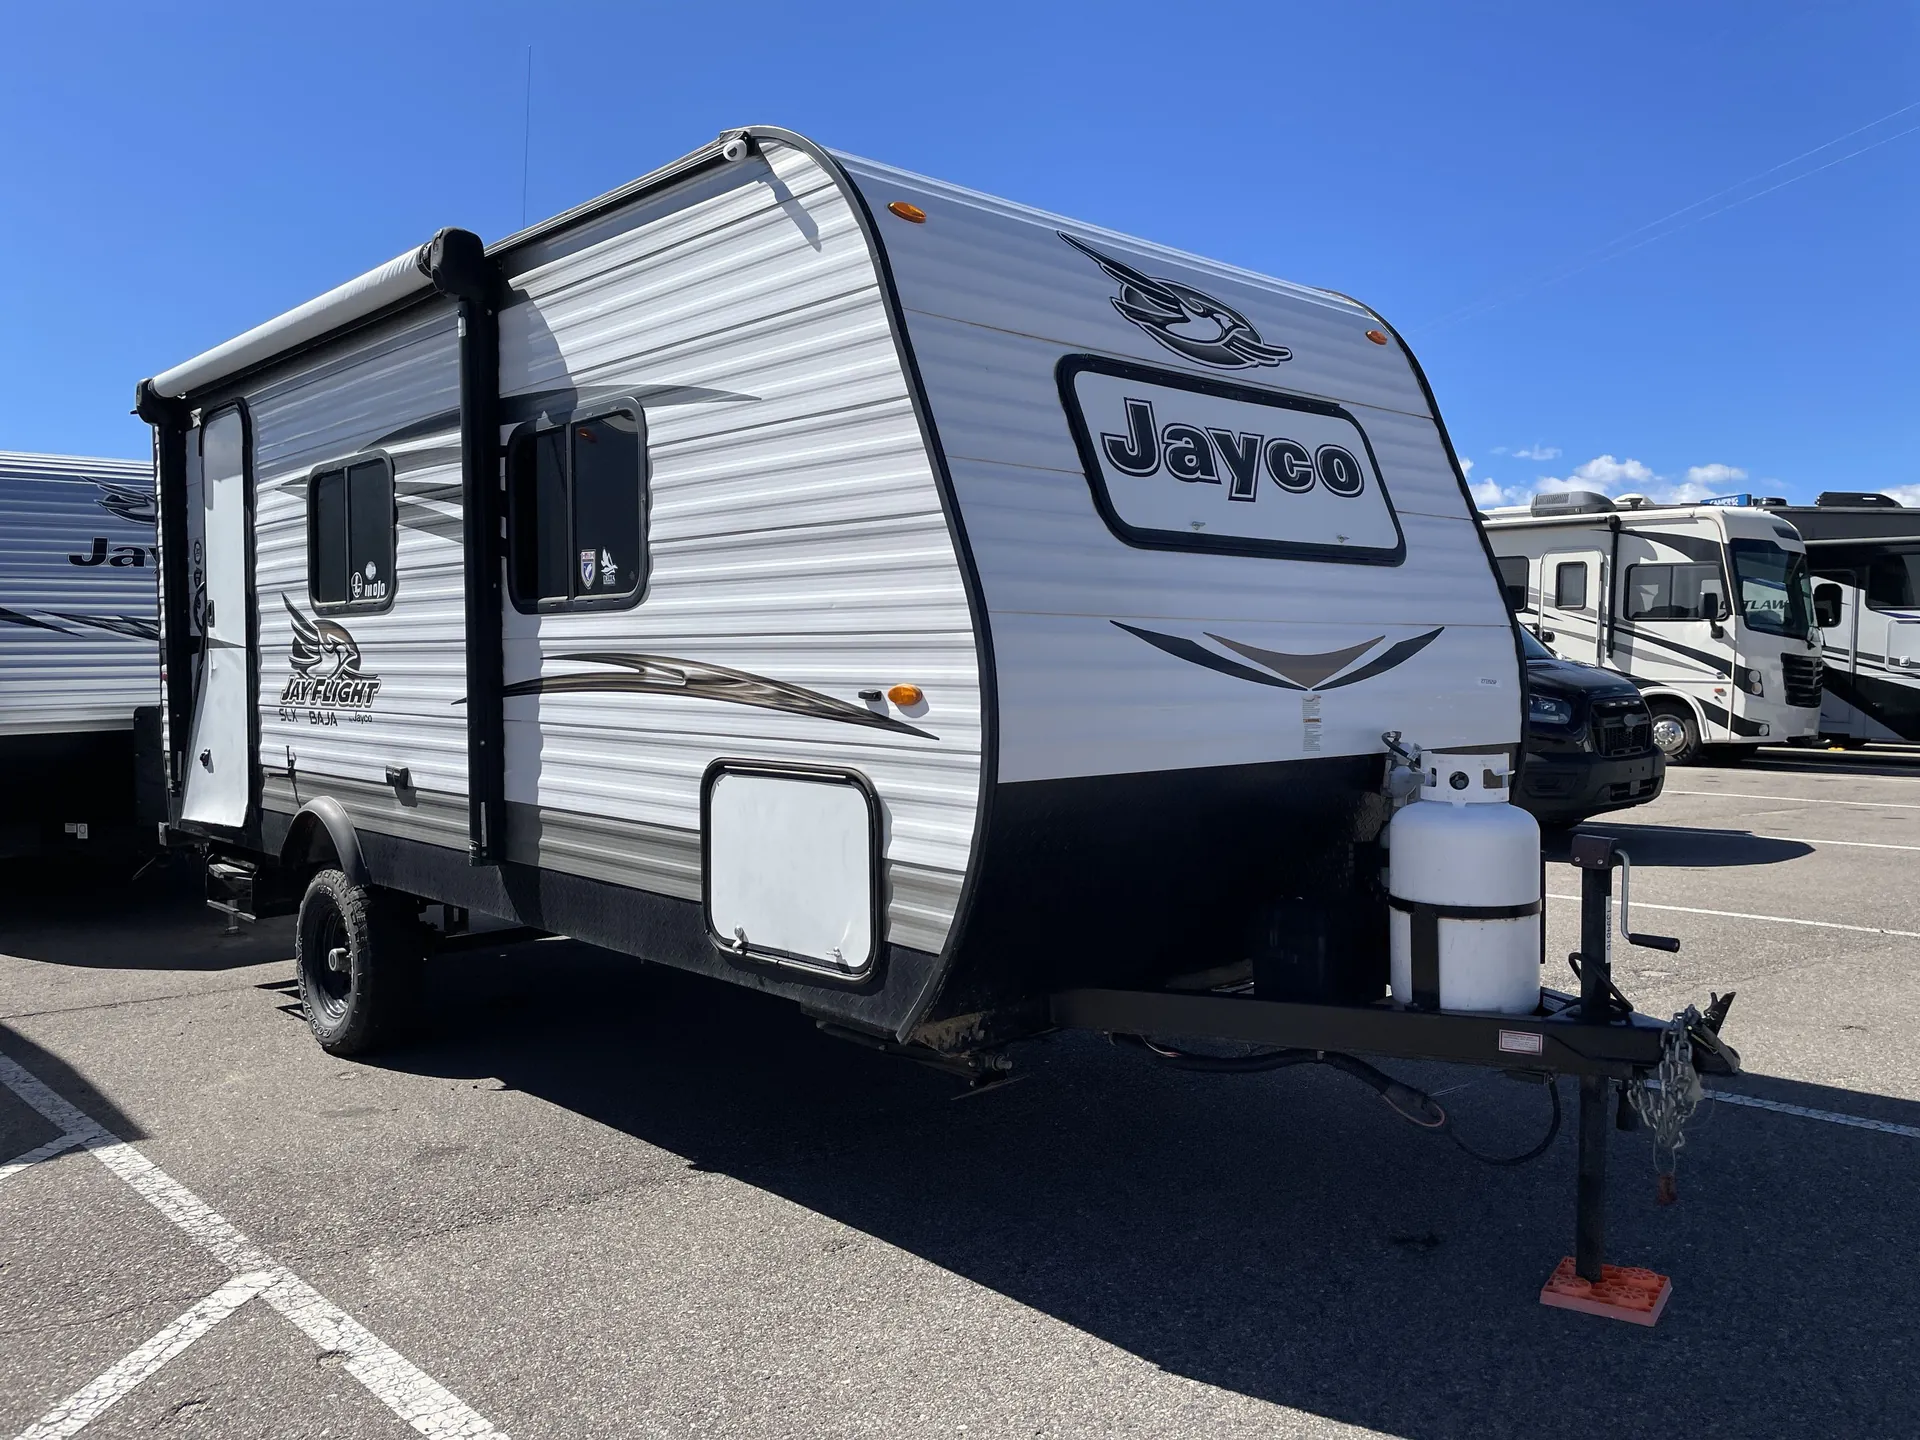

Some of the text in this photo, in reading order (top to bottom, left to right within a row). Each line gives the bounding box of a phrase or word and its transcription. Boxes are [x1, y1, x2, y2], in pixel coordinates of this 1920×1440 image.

[1100, 397, 1365, 502] Jayco
[1720, 600, 1788, 610] TLAW
[280, 674, 381, 708] JAY FLIGHT
[279, 708, 299, 723] SLX
[308, 710, 339, 727] BAJA
[353, 710, 373, 725] Jayco
